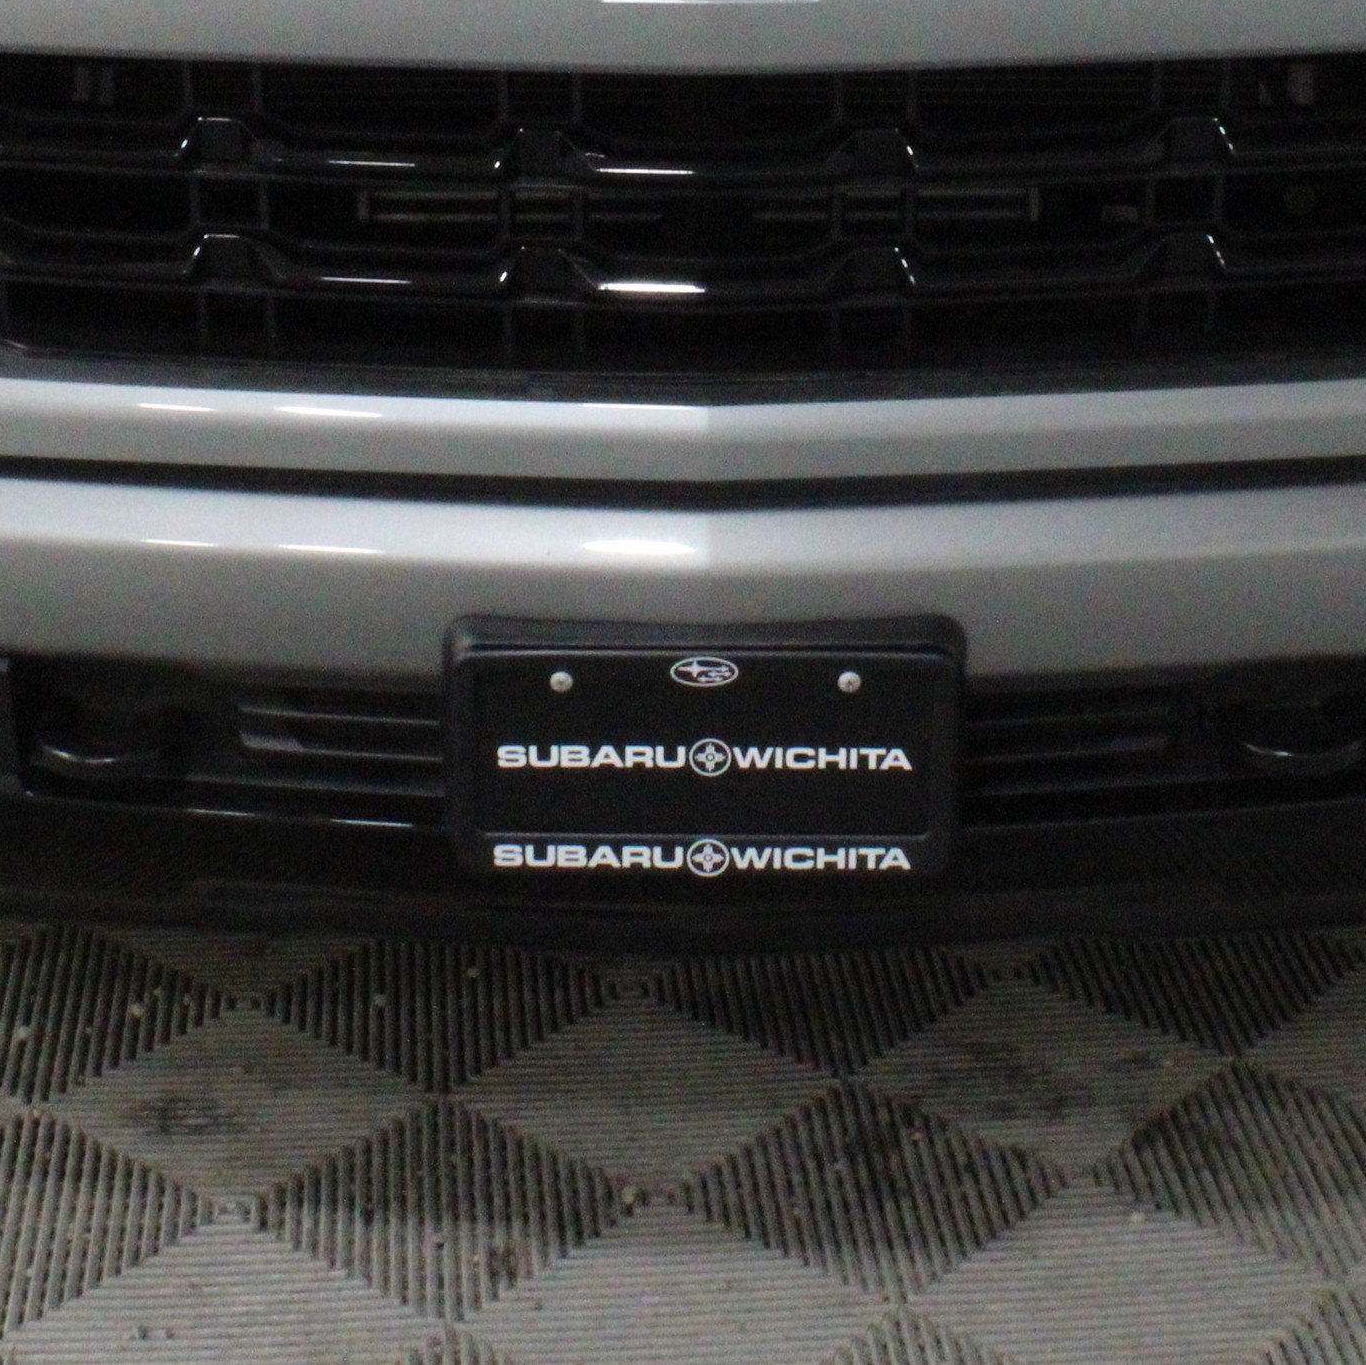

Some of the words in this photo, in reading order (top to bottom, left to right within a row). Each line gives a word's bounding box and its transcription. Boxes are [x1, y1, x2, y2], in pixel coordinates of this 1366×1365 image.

[497, 745, 686, 768] SUBARU
[733, 747, 912, 770] WICHITA
[494, 845, 683, 868] SUBARU
[731, 848, 910, 869] WICHITA
